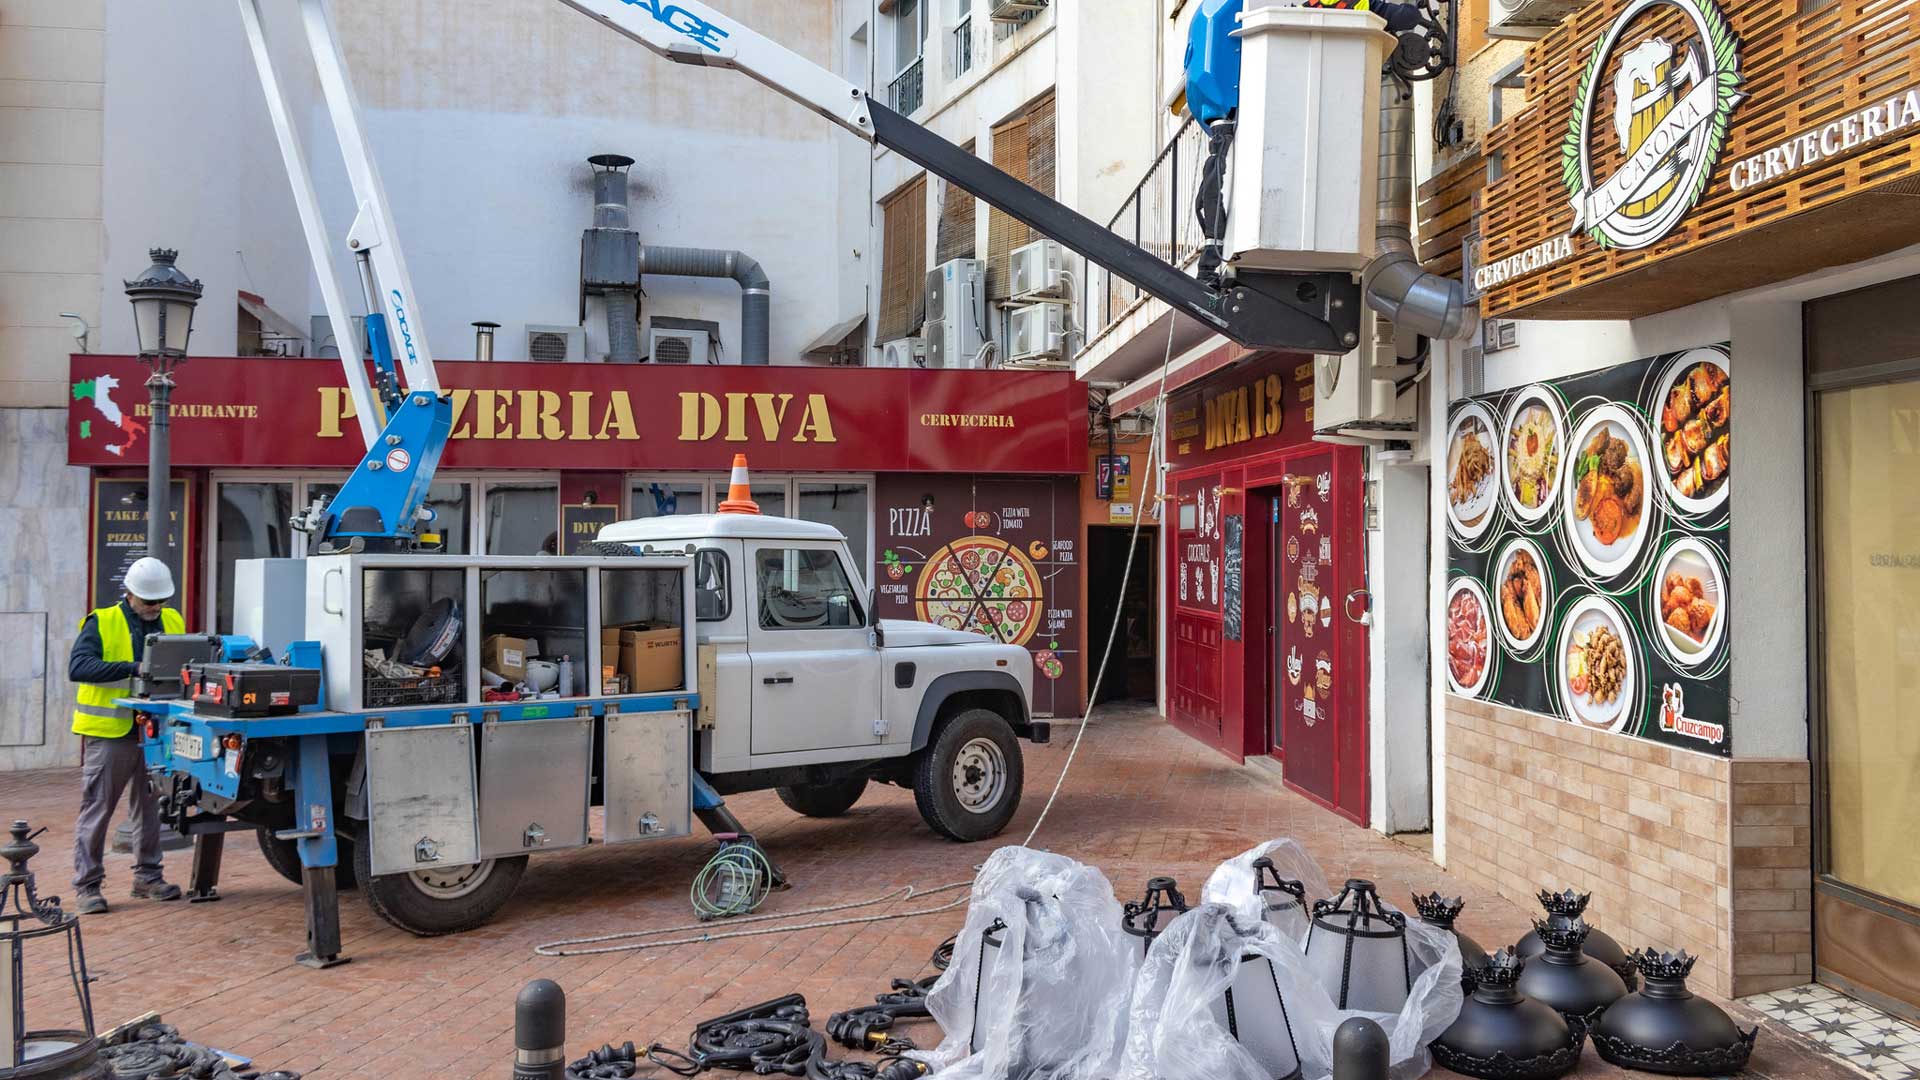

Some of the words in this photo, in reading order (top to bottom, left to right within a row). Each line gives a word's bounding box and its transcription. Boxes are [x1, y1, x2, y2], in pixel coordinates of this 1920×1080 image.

[1729, 90, 1920, 192] CERVECERIA
[1592, 189, 1616, 220] LA
[1619, 101, 1700, 191] CASONA
[1474, 233, 1573, 290] CERVECERIA
[134, 403, 258, 419] RTAURANTE
[316, 386, 640, 441] PZERIA
[677, 391, 837, 443] DIVA
[1204, 386, 1252, 450] DIVA
[1254, 373, 1283, 439] 13
[920, 413, 1015, 428] CERVECERIA
[105, 510, 139, 521] TAKE
[143, 510, 178, 521] AY
[1002, 507, 1016, 518] PIZZA
[1016, 507, 1030, 518] WITH
[889, 507, 931, 537] PIZZA
[1003, 519, 1023, 529] TOMATO
[107, 532, 145, 542] PIZZAS
[1052, 540, 1074, 551] SEAFOOD
[1187, 543, 1210, 563] COCKTAILS
[1060, 551, 1074, 562] PIZZA
[880, 584, 909, 594] VEGETARIAN
[895, 595, 909, 605] PIZZA
[1675, 716, 1723, 742] Cruzcampo
